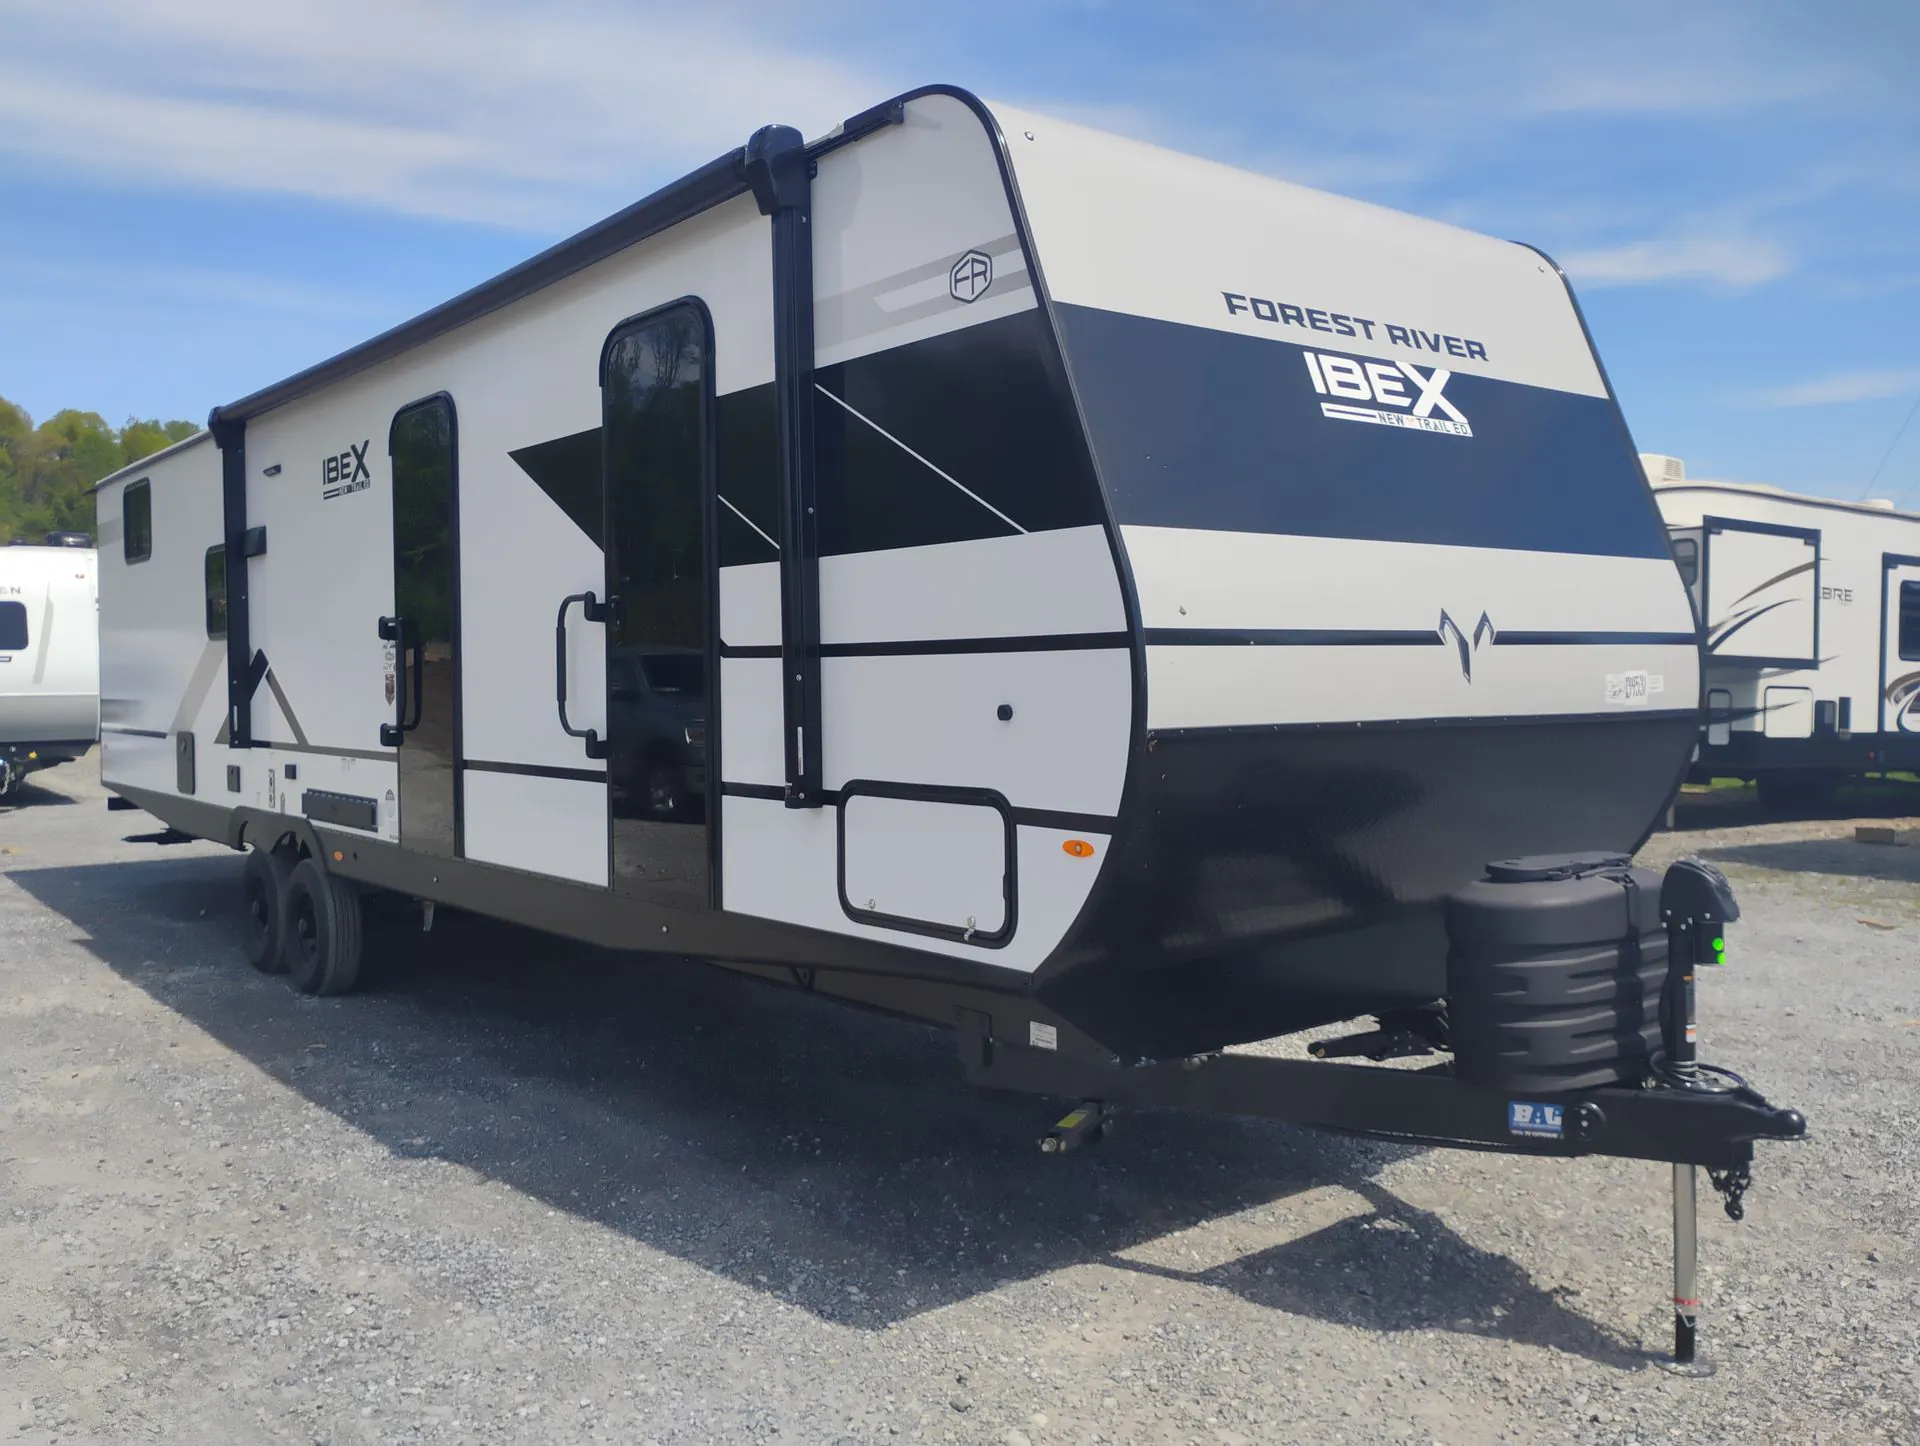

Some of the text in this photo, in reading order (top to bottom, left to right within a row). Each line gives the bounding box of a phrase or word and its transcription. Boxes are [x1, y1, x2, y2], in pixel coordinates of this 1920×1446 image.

[1220, 289, 1490, 362] FOREST RIVER
[1302, 350, 1469, 423] IBEX
[1377, 411, 1405, 427] NEW
[1415, 418, 1451, 433] TRAIL
[322, 439, 371, 486] IBEX
[1819, 587, 1853, 602] BRE
